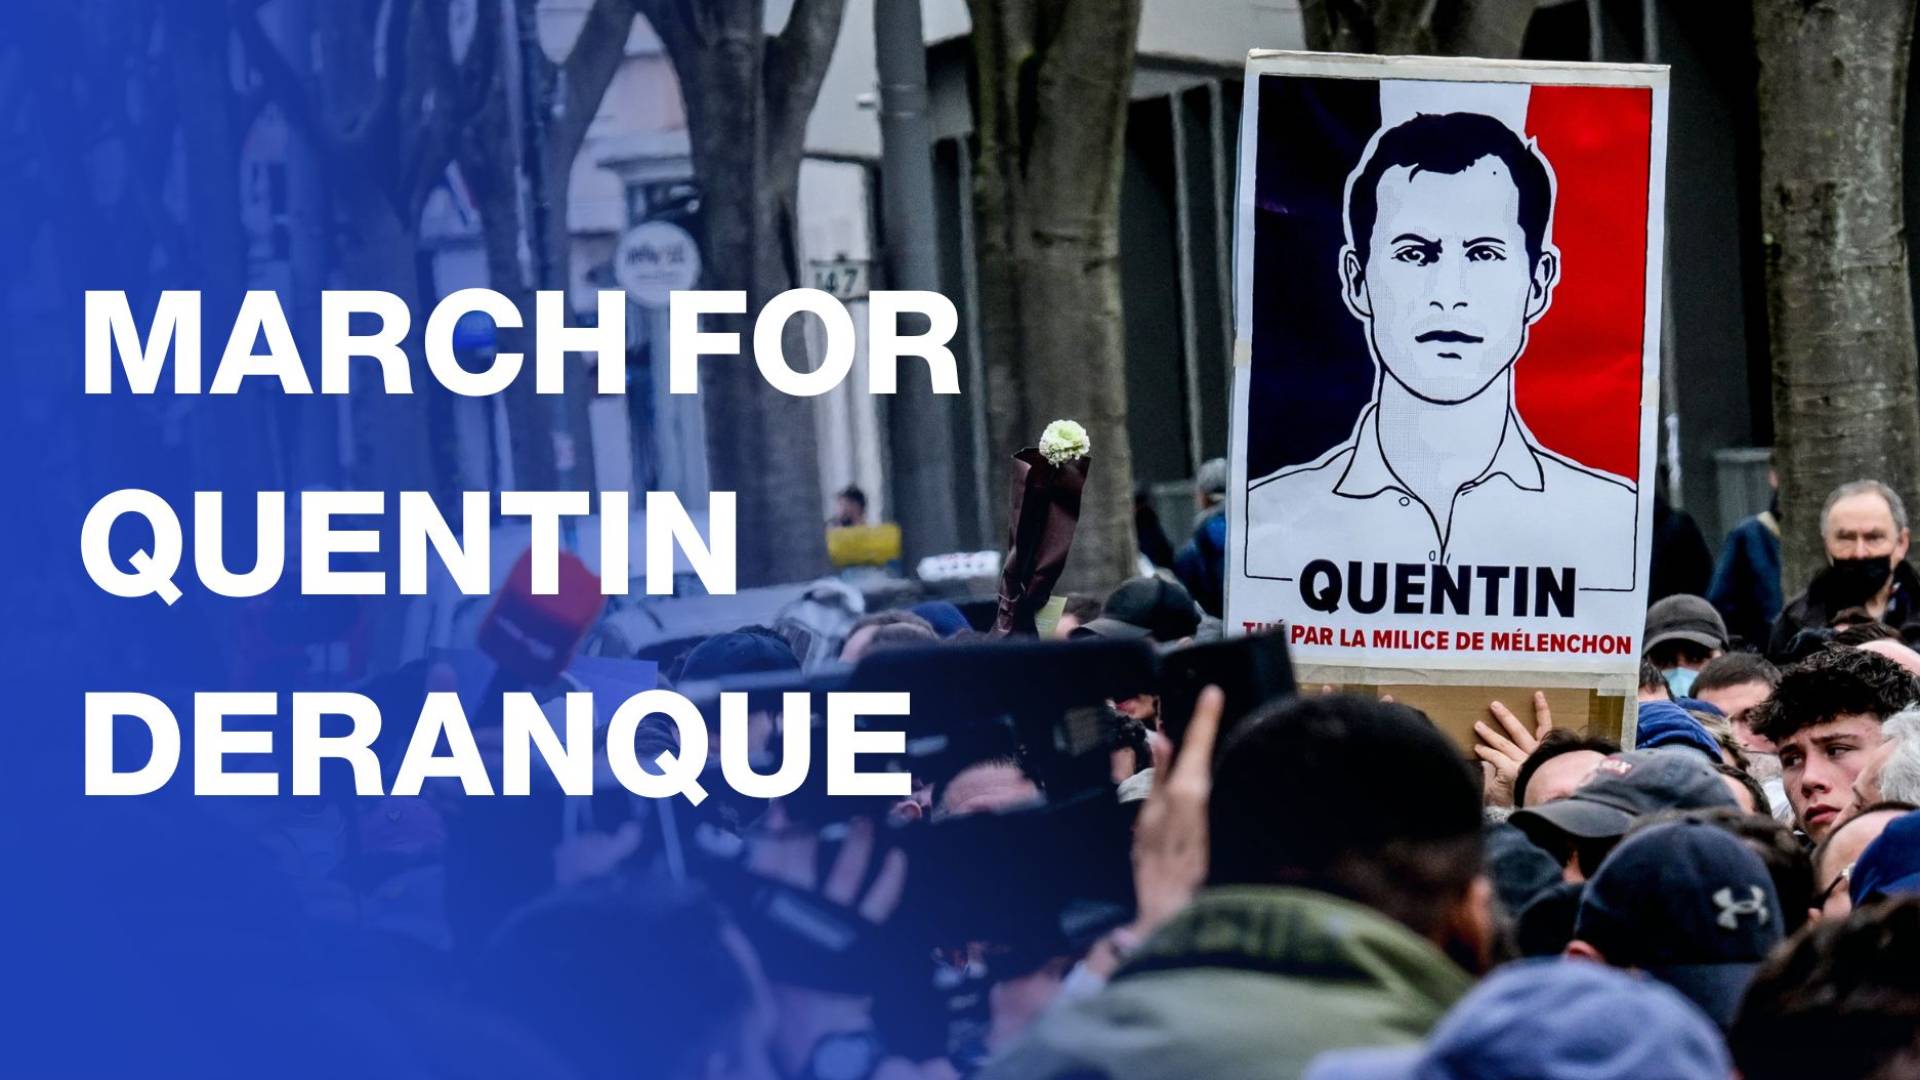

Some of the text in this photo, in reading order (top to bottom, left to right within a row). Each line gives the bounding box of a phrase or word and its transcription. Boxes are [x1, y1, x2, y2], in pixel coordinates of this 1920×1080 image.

[1299, 558, 1577, 618] QUENTIN
[1290, 624, 1334, 646] PAR
[1340, 628, 1367, 648] LA
[1372, 629, 1450, 650] MILICE
[1455, 631, 1485, 651] DE
[1490, 627, 1632, 655] MÉLENCHON
